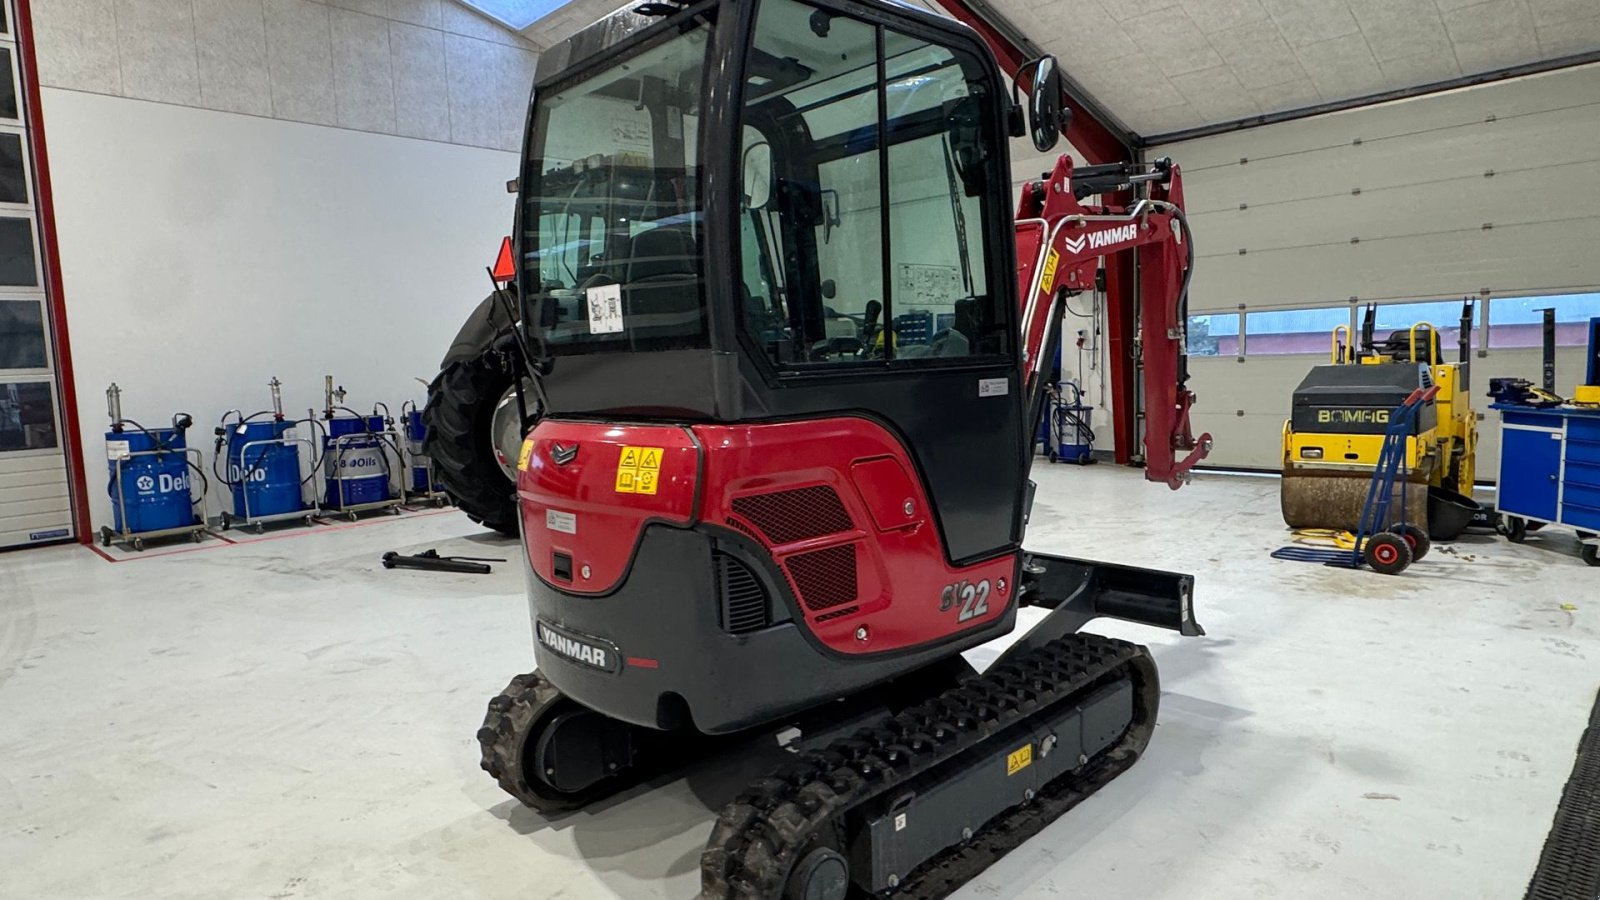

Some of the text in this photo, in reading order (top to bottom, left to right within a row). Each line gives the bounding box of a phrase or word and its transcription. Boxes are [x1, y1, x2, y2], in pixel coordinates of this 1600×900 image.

[1087, 224, 1137, 249] YANMAR
[357, 457, 376, 467] Oils
[542, 626, 606, 667] YANMAR
